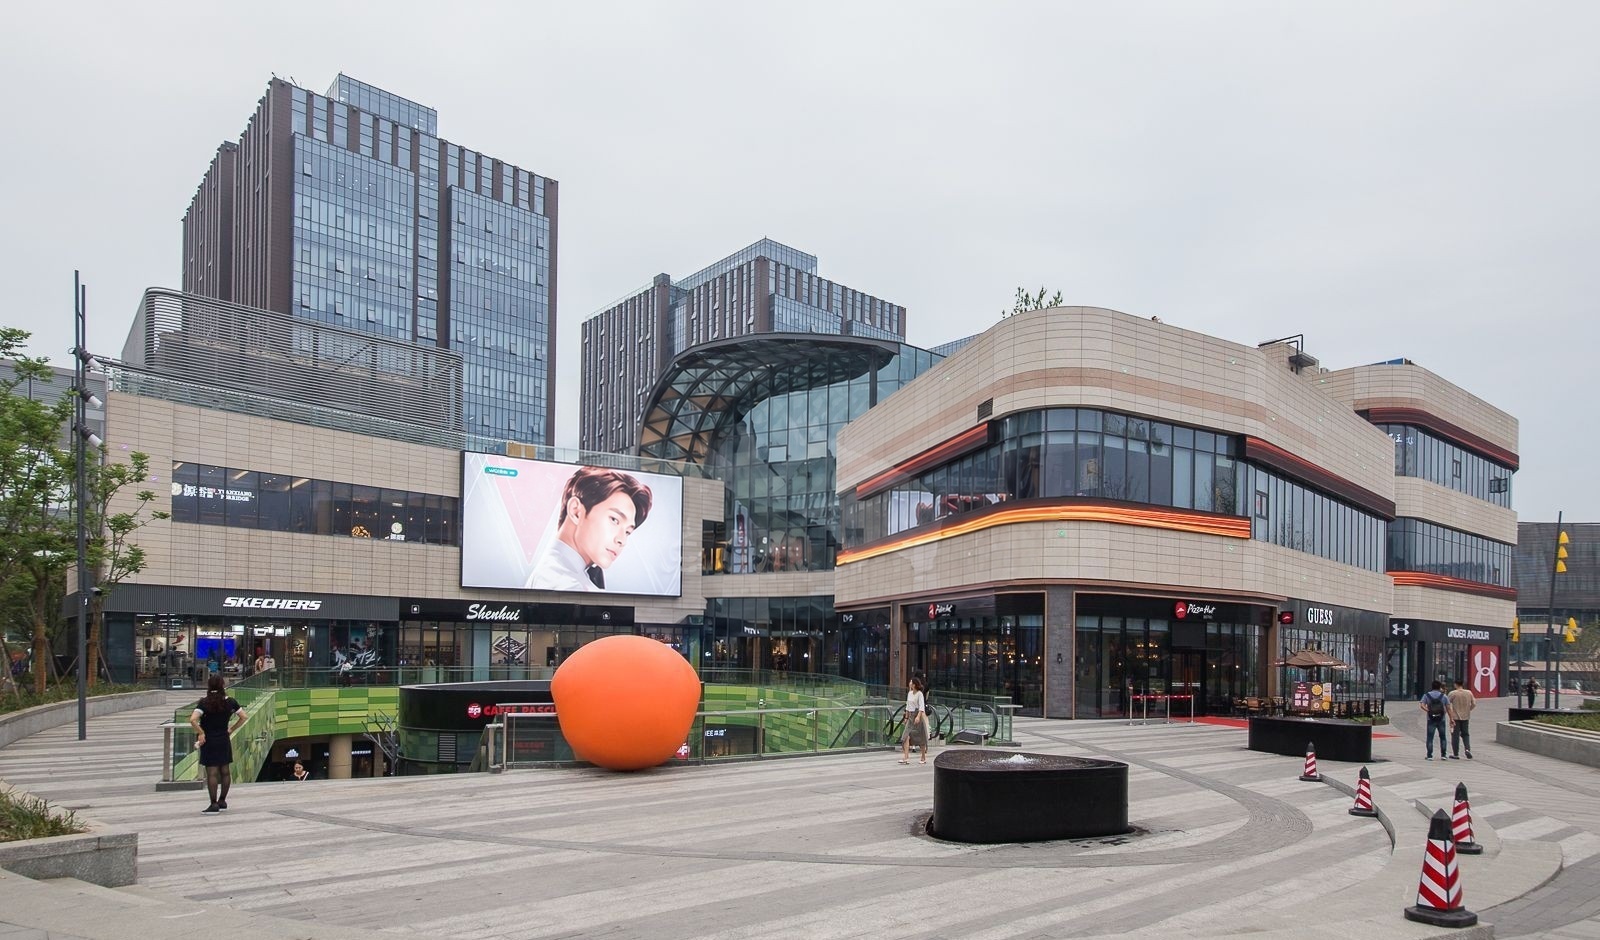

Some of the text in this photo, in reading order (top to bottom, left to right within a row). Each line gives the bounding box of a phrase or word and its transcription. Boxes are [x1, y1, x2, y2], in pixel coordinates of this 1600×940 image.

[223, 596, 322, 611] SKECHERS
[1187, 603, 1216, 614] Pizza Hut
[466, 603, 521, 621] Shenhui
[1307, 607, 1333, 626] GUESS
[1447, 627, 1490, 641] UNDER ARMOUR
[483, 705, 517, 716] CAFFE
